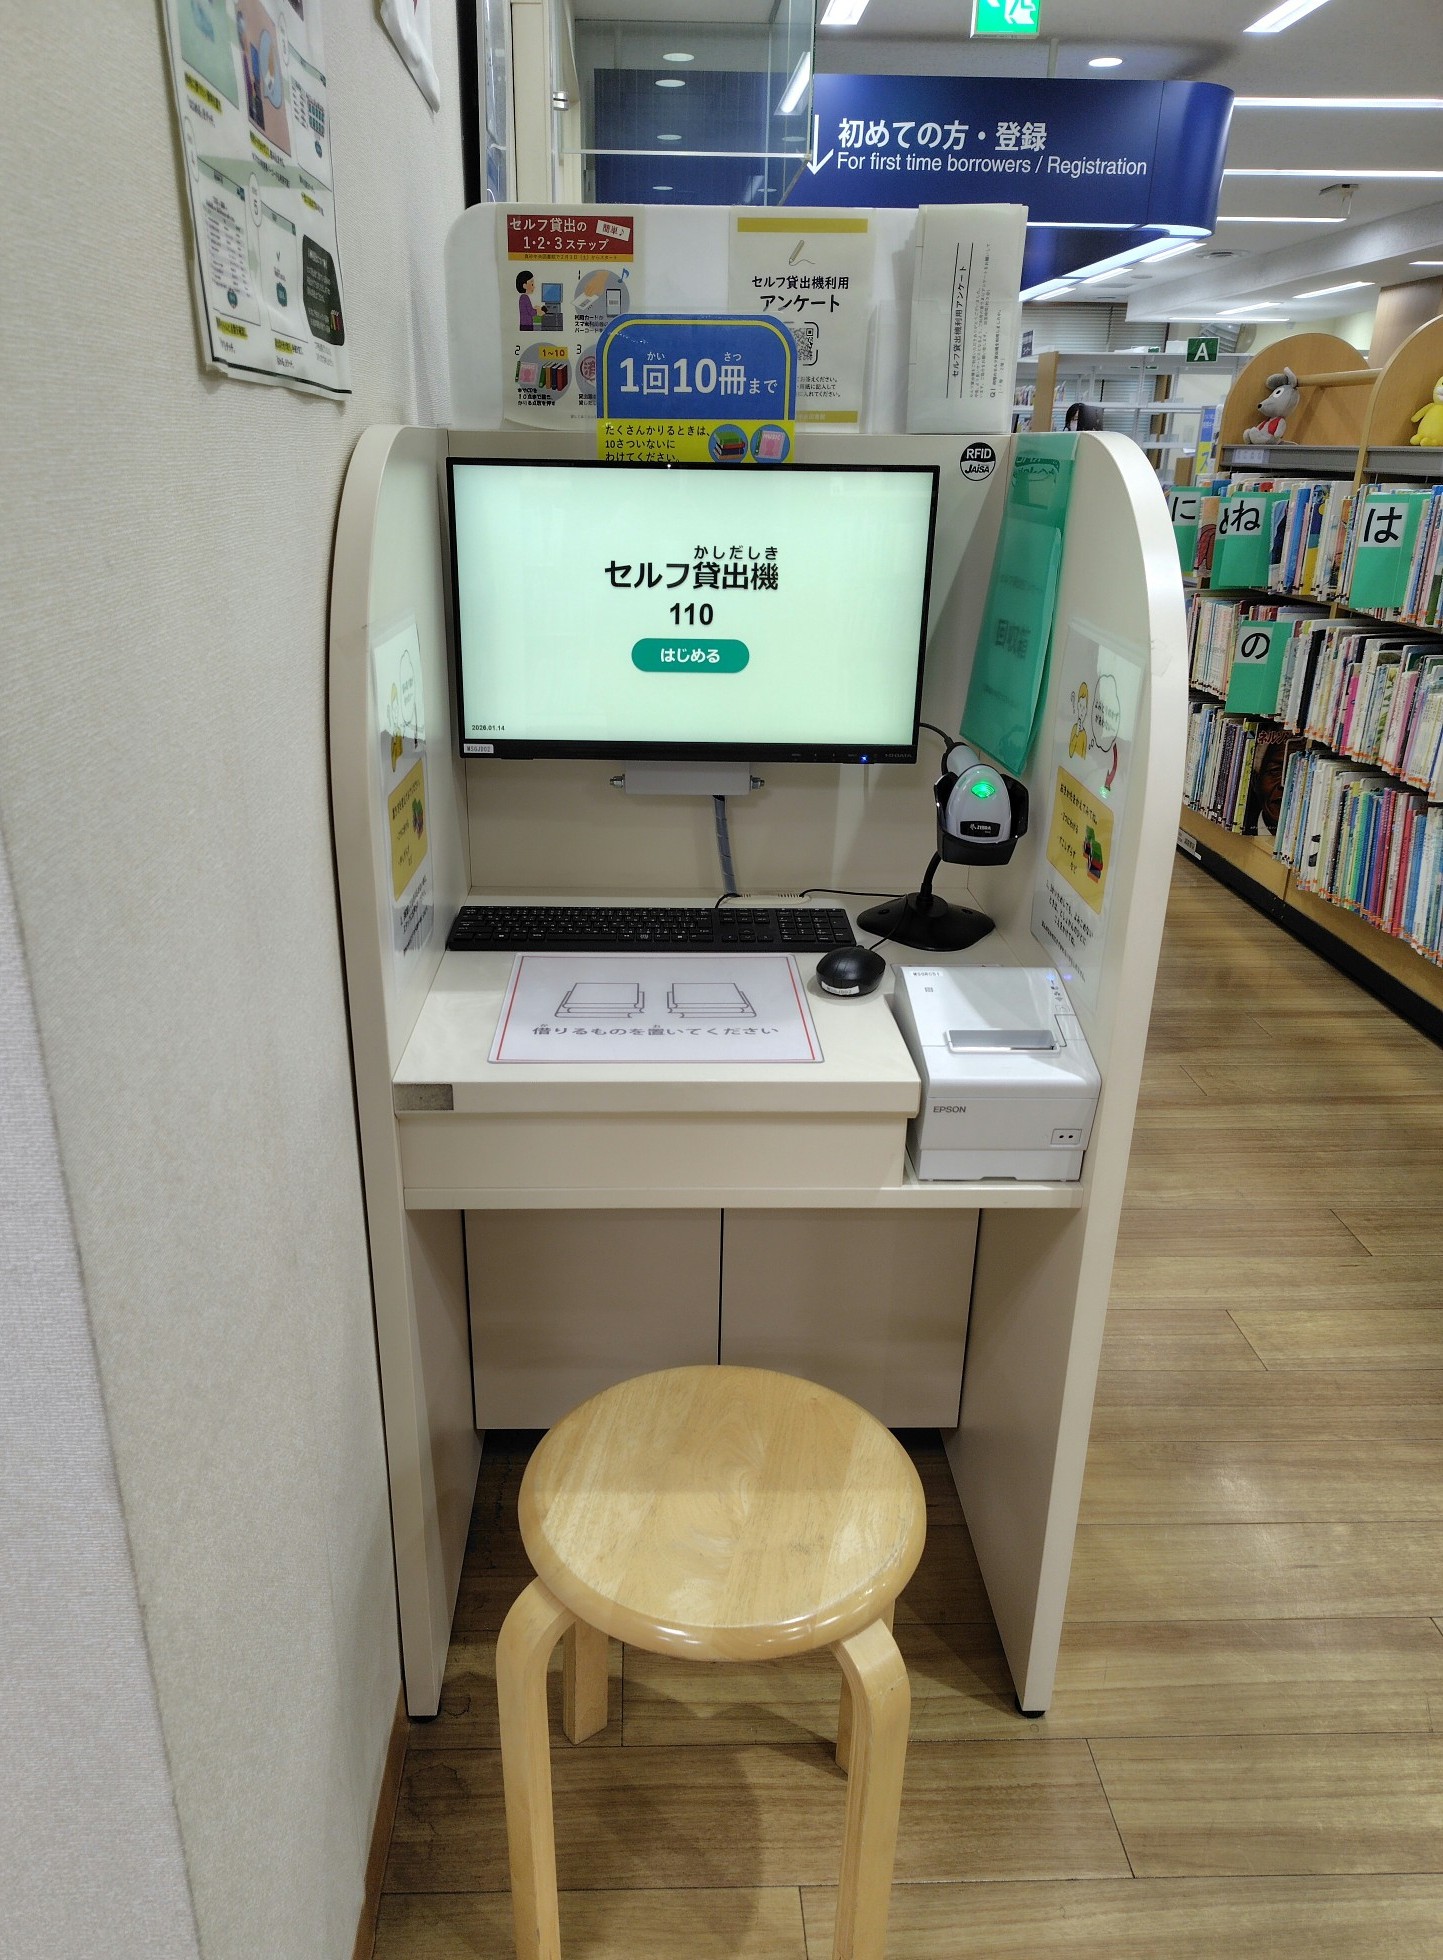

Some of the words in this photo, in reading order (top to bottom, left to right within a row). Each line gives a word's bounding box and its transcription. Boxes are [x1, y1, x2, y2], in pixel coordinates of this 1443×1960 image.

[838, 118, 1048, 152] 初めての方・登録
[837, 152, 865, 170] For
[870, 153, 901, 172] first
[906, 154, 942, 172] time
[947, 154, 1031, 175] borrowers
[1035, 156, 1043, 174] /
[1047, 156, 1147, 178] Registration
[510, 217, 587, 233] セルフ貸出の
[751, 275, 850, 291] セルフ貸出機利用
[760, 294, 841, 313] アンケート
[951, 265, 966, 378] セルフ貸出機利用アンケート
[647, 352, 666, 361] かい
[724, 352, 742, 361] さつ
[1194, 342, 1210, 361] A
[620, 357, 778, 395] 1回10冊まで
[605, 425, 712, 437] たくさんかりるときは、
[605, 439, 676, 450] 10さついないに
[966, 448, 992, 459] RFID
[605, 452, 681, 463] わけてください。
[1172, 496, 1196, 522] に
[1233, 500, 1261, 532] ね
[1363, 506, 1403, 544] は
[694, 545, 779, 561] かしだしき
[604, 560, 779, 591] セルフ貸出機
[670, 603, 714, 626] 110
[1241, 632, 1271, 660] の
[660, 647, 721, 665] はじめる
[532, 1026, 780, 1036] 借りるものを置いてください
[932, 1105, 967, 1114] EPSON
